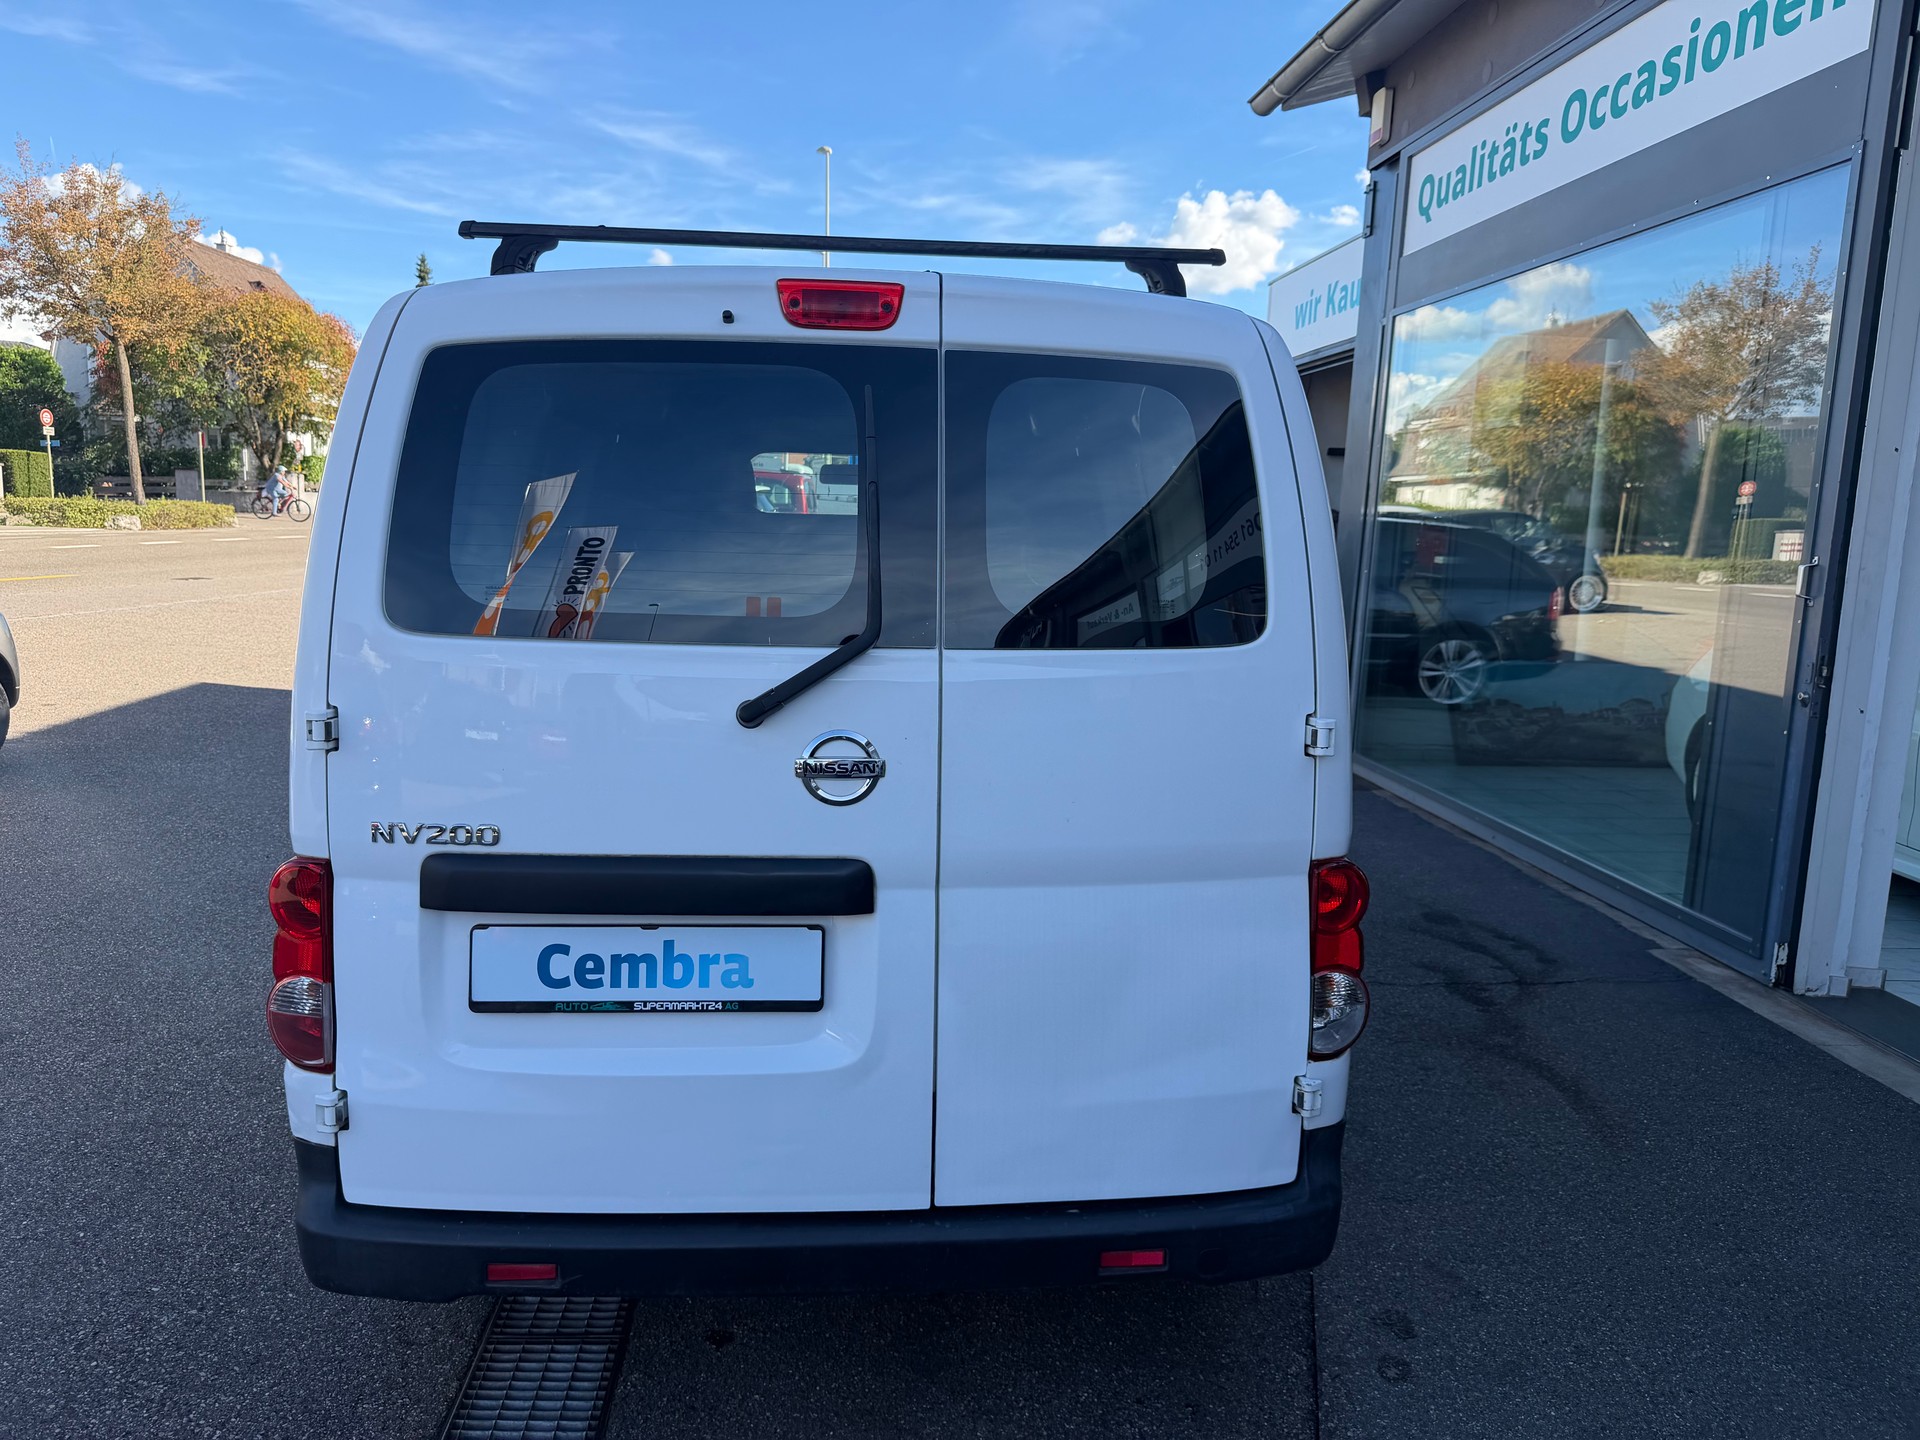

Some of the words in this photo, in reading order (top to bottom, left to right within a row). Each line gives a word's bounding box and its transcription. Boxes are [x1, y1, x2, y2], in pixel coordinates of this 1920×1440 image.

[1418, 117, 1550, 223] Qualitäts
[1295, 288, 1322, 330] wir
[563, 537, 606, 595] PRONTO
[805, 762, 877, 776] NISSAN
[370, 821, 500, 846] NV200
[536, 939, 755, 990] Cembra
[555, 1002, 589, 1011] AUTO
[633, 1001, 723, 1011] SUPERMARKT24
[724, 1001, 739, 1010] AG
